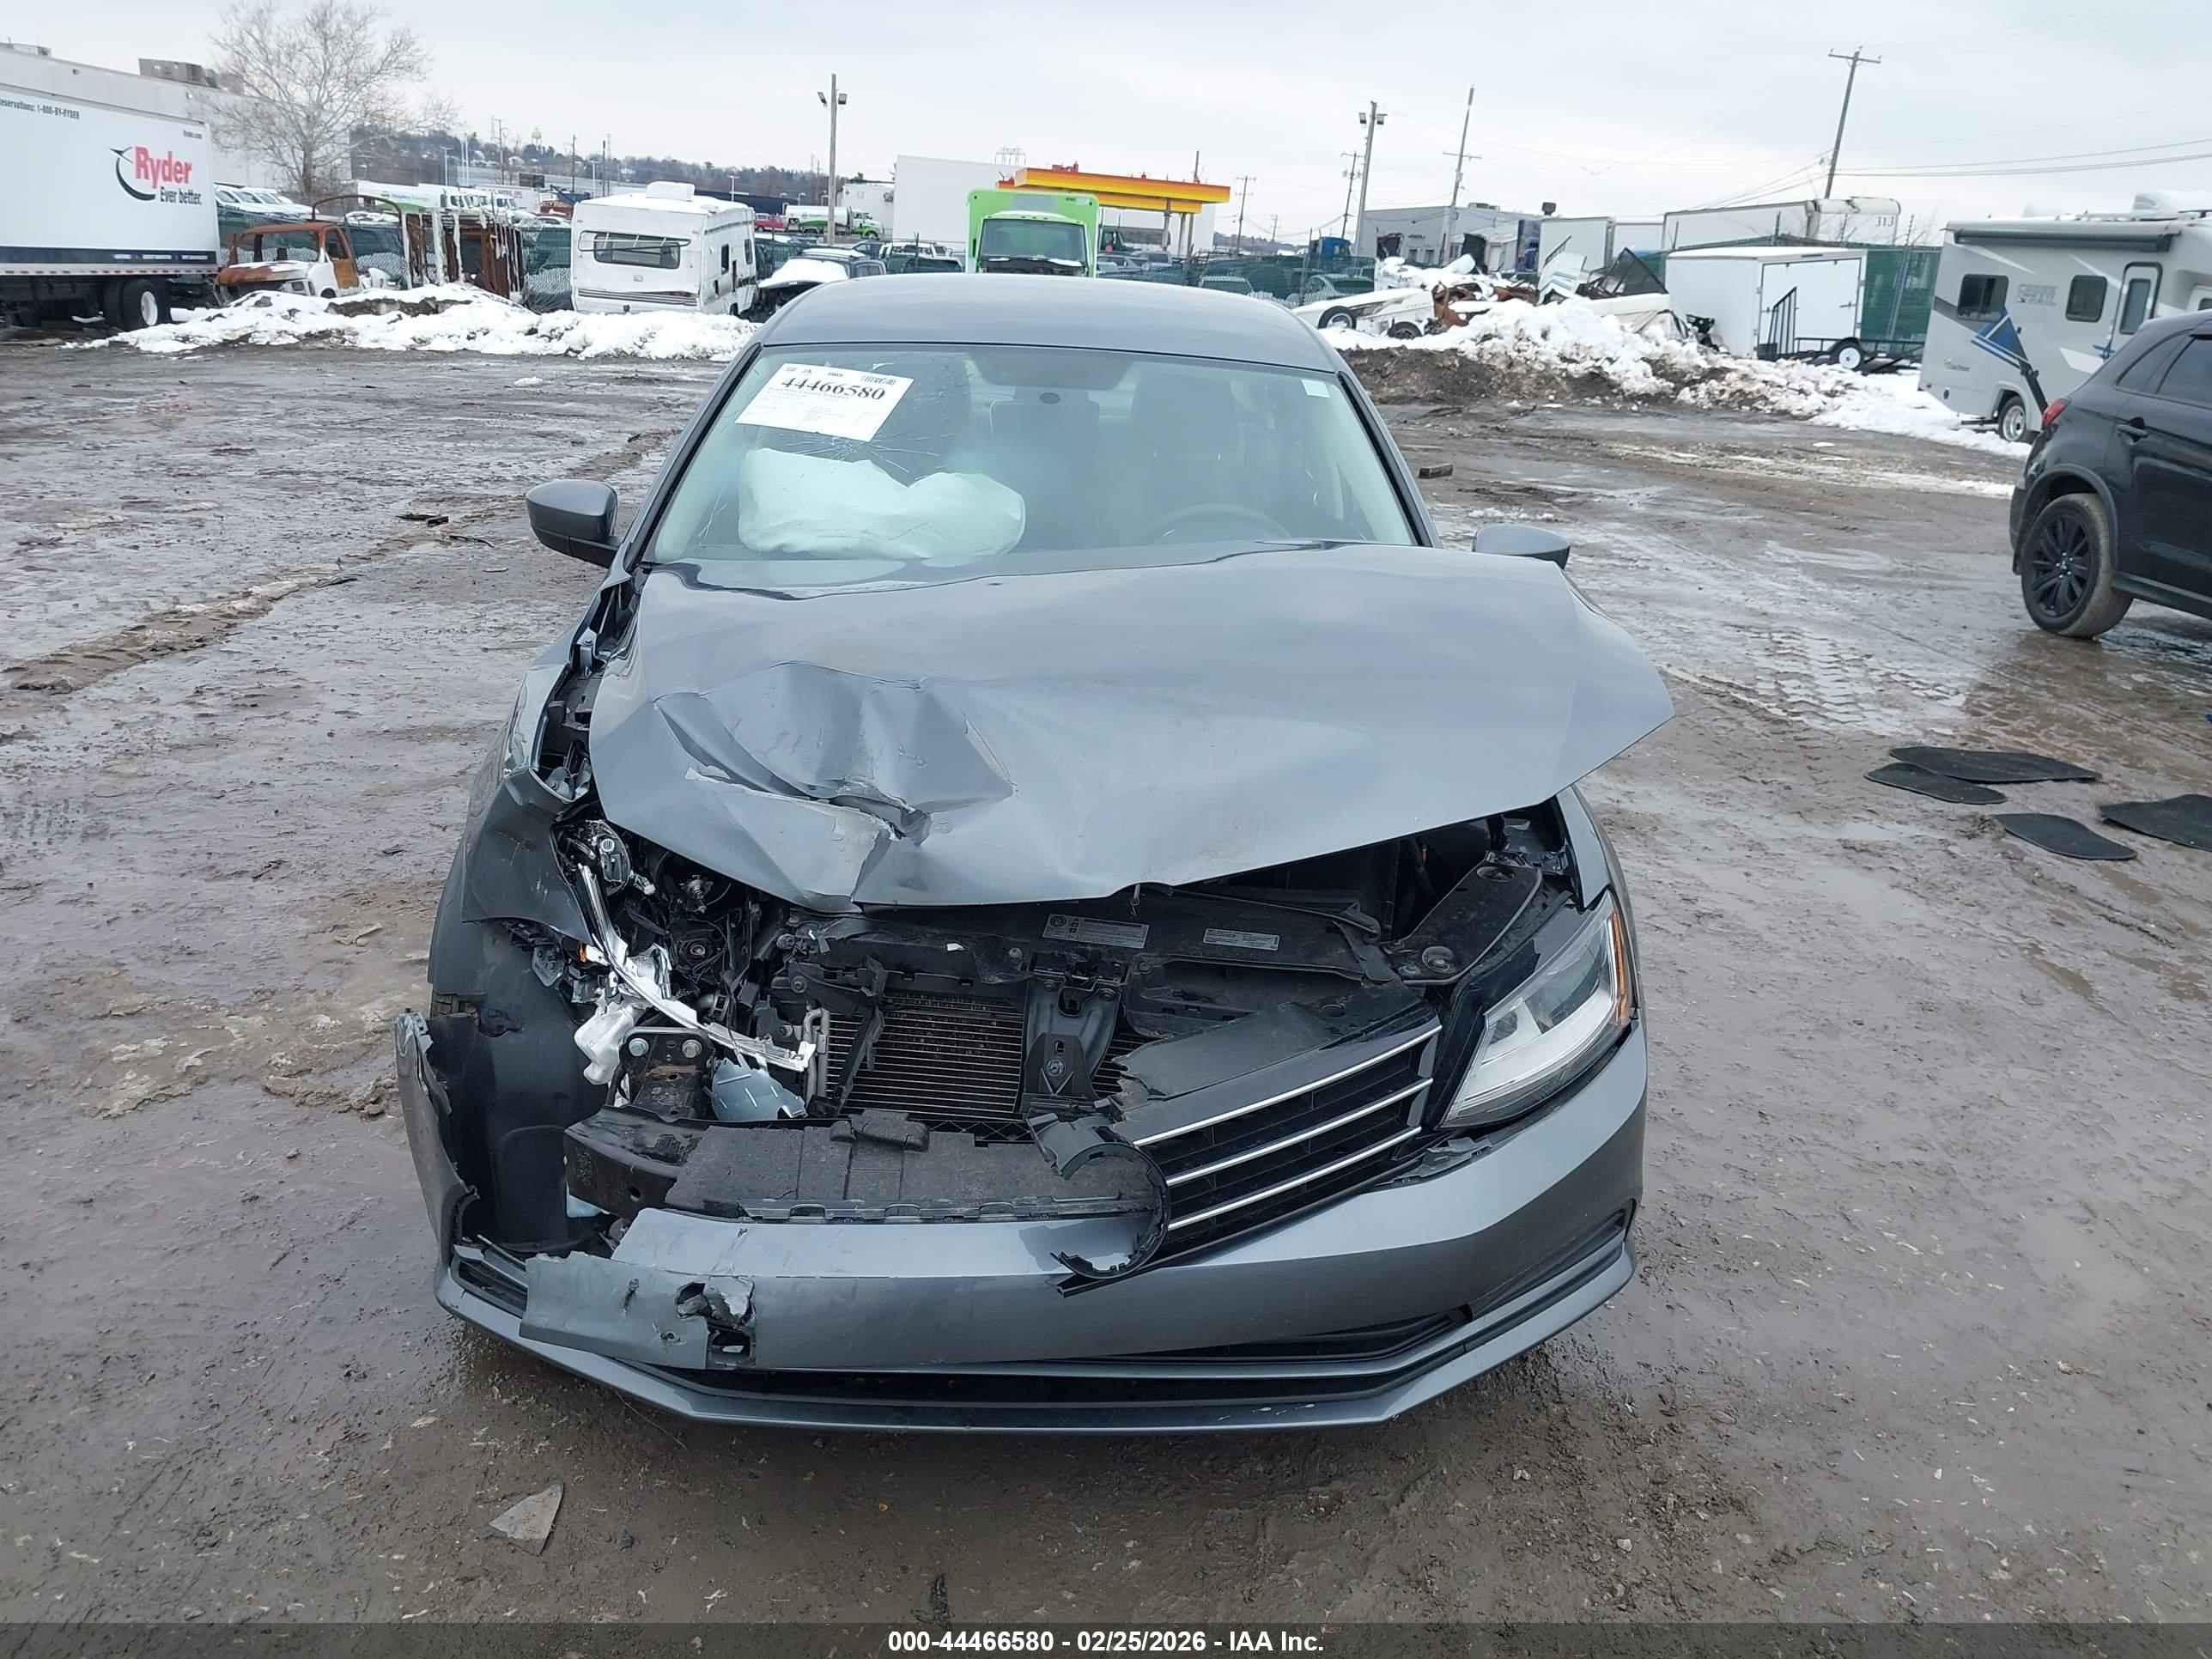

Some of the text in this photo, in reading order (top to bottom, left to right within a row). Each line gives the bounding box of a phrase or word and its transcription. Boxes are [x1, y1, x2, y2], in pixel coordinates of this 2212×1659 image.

[135, 145, 192, 189] Ryder
[160, 185, 202, 205] Ever better.
[781, 377, 886, 400] 44466580
